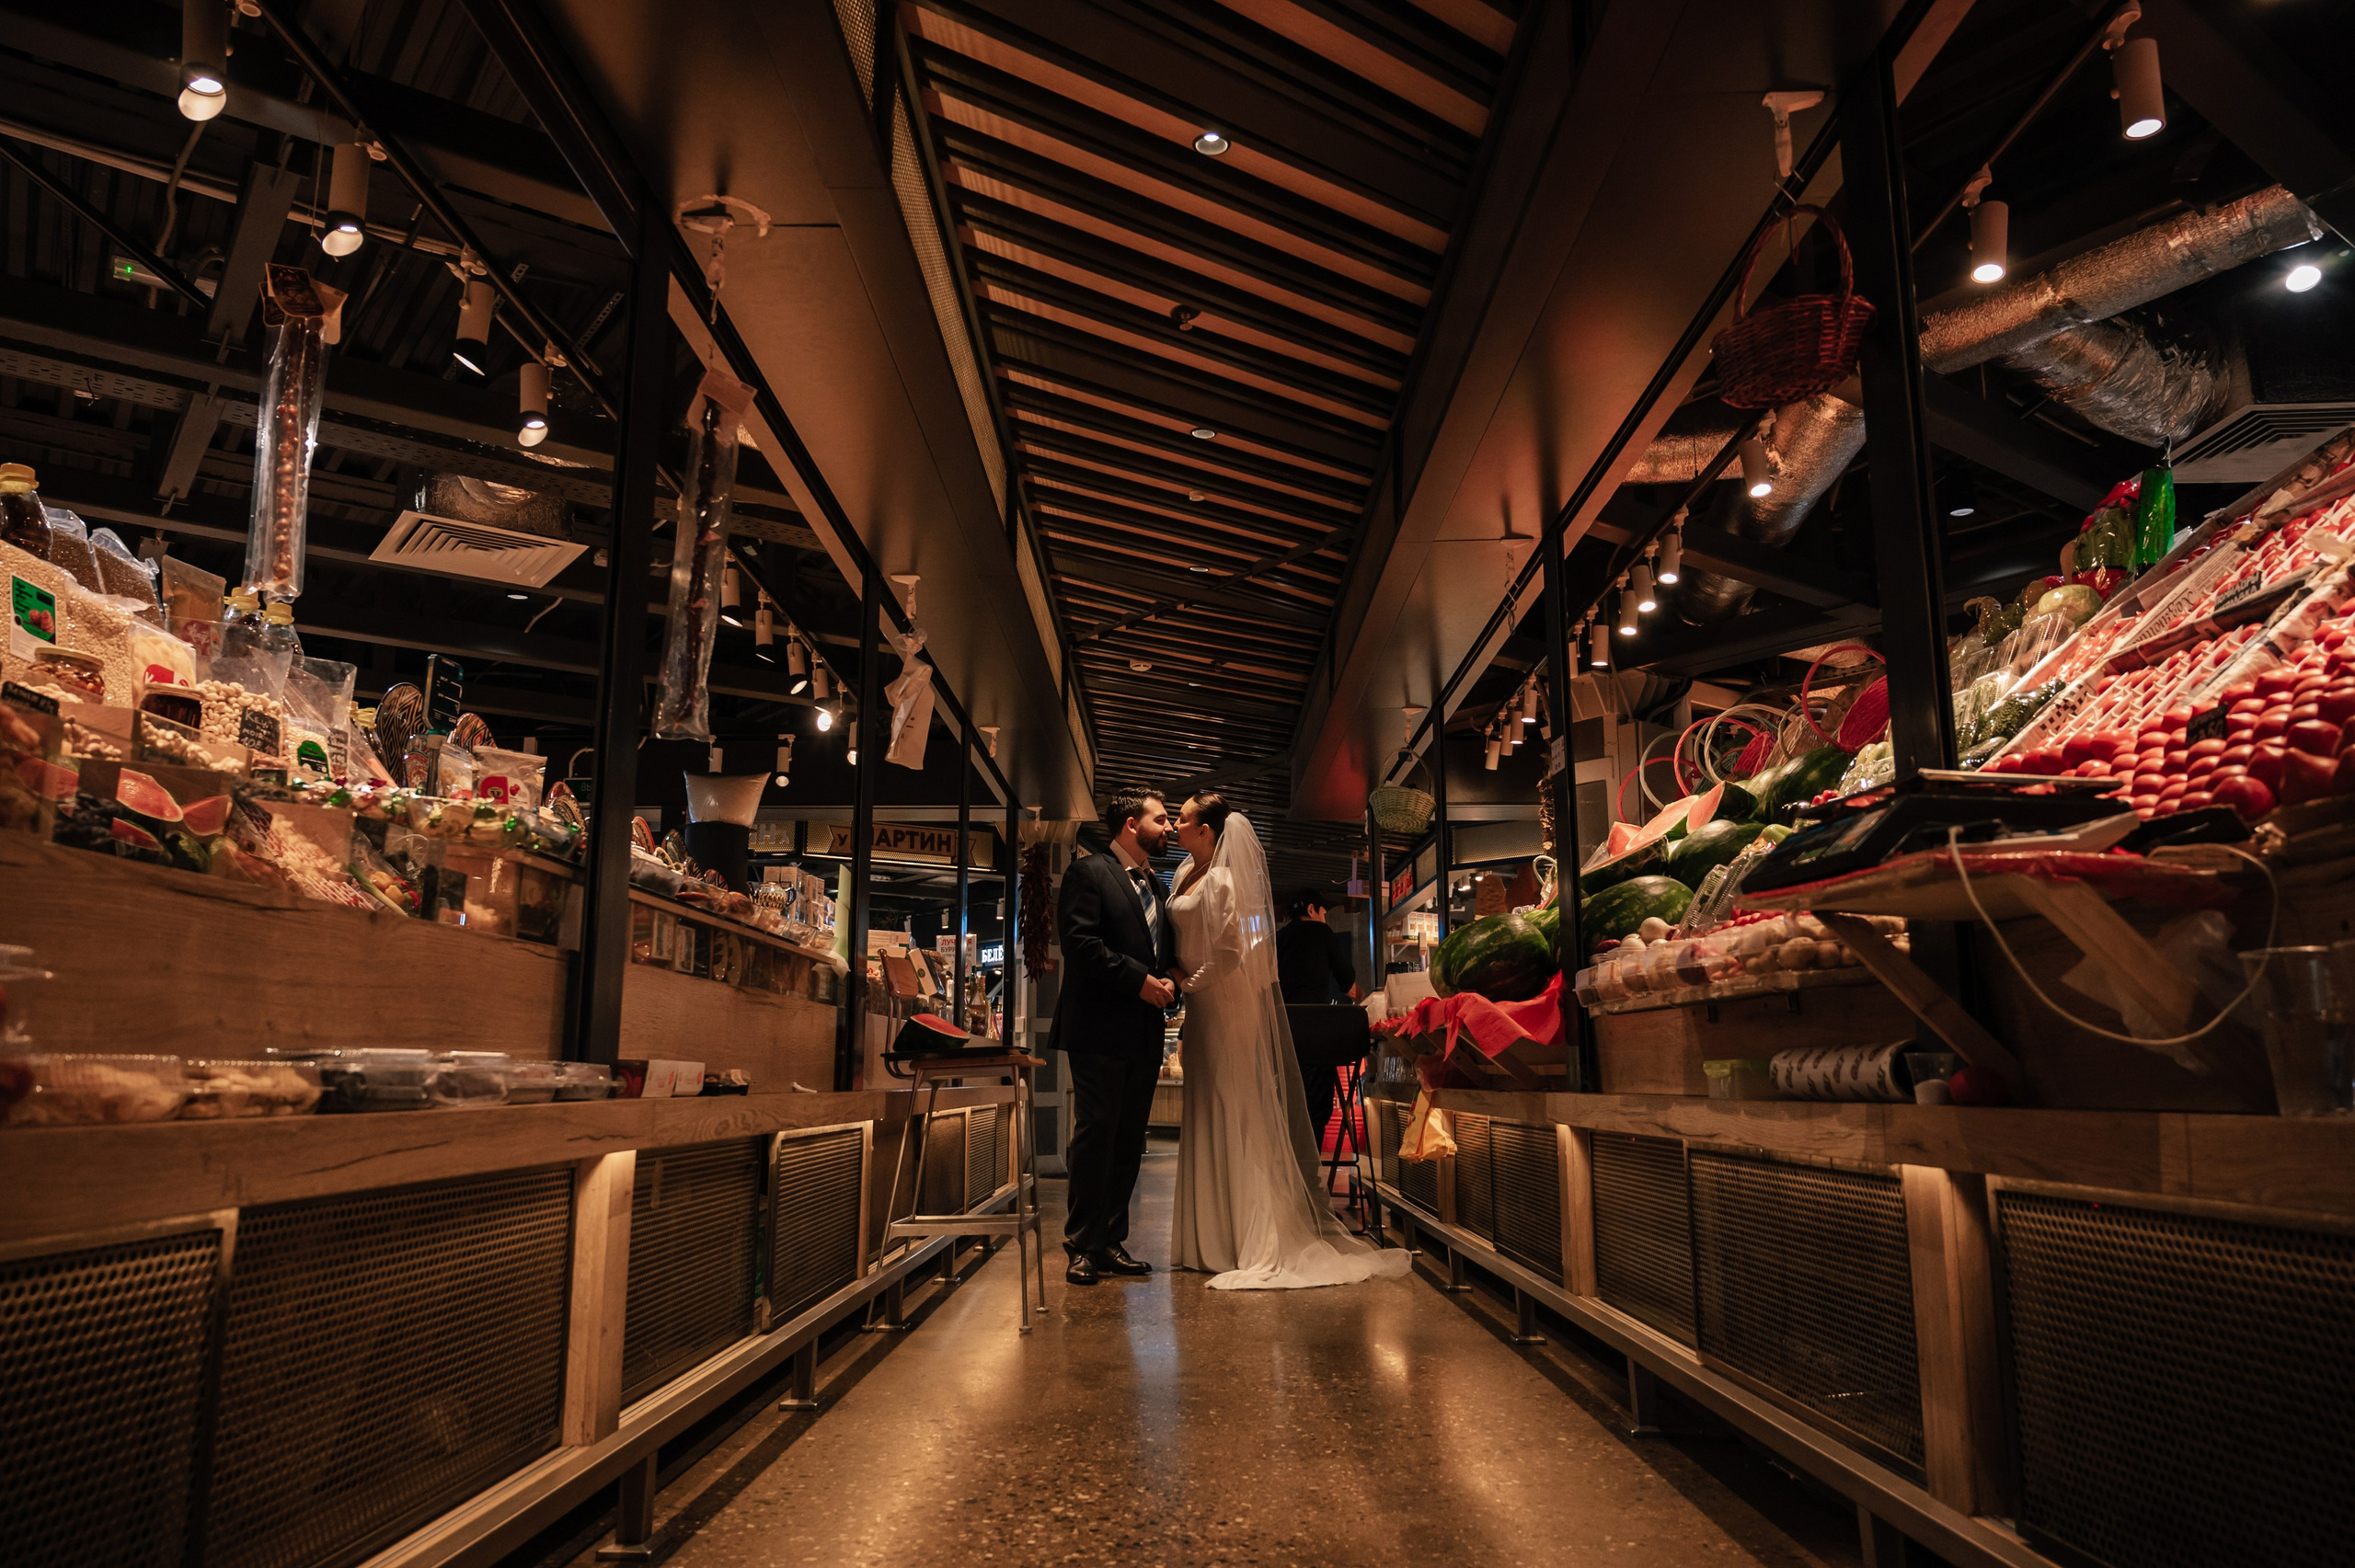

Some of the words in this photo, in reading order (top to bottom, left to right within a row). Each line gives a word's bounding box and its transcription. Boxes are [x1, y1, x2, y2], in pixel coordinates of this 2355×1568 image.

[837, 833, 848, 846] У
[870, 828, 951, 853] АРТИН
[941, 938, 972, 946] ЛУЧЯ
